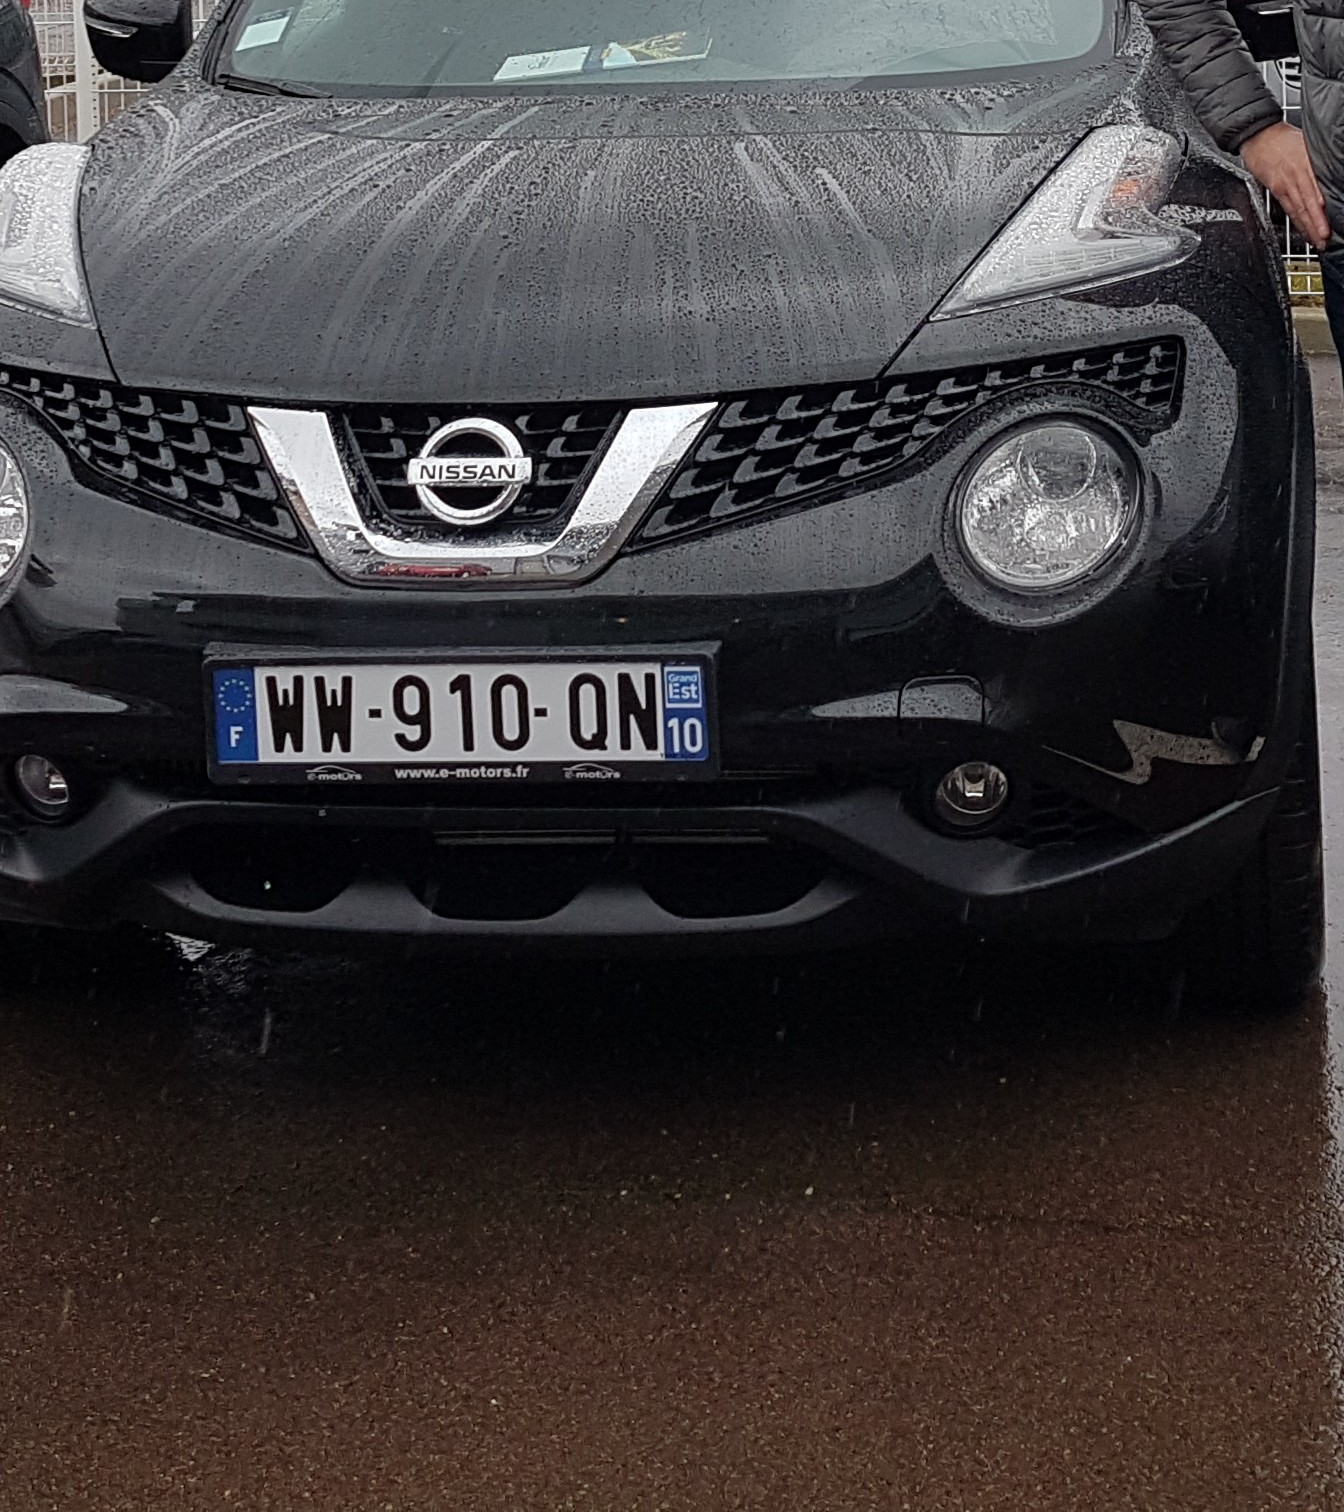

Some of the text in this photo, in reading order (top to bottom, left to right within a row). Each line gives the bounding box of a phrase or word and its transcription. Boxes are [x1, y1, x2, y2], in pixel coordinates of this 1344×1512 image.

[419, 464, 516, 480] NISSAN
[668, 673, 698, 683] Grand
[668, 683, 699, 699] Est
[265, 672, 658, 753] WW-910-QN
[229, 726, 244, 748] F
[667, 717, 703, 754] 10
[394, 765, 530, 779] www.e-motors.fr
